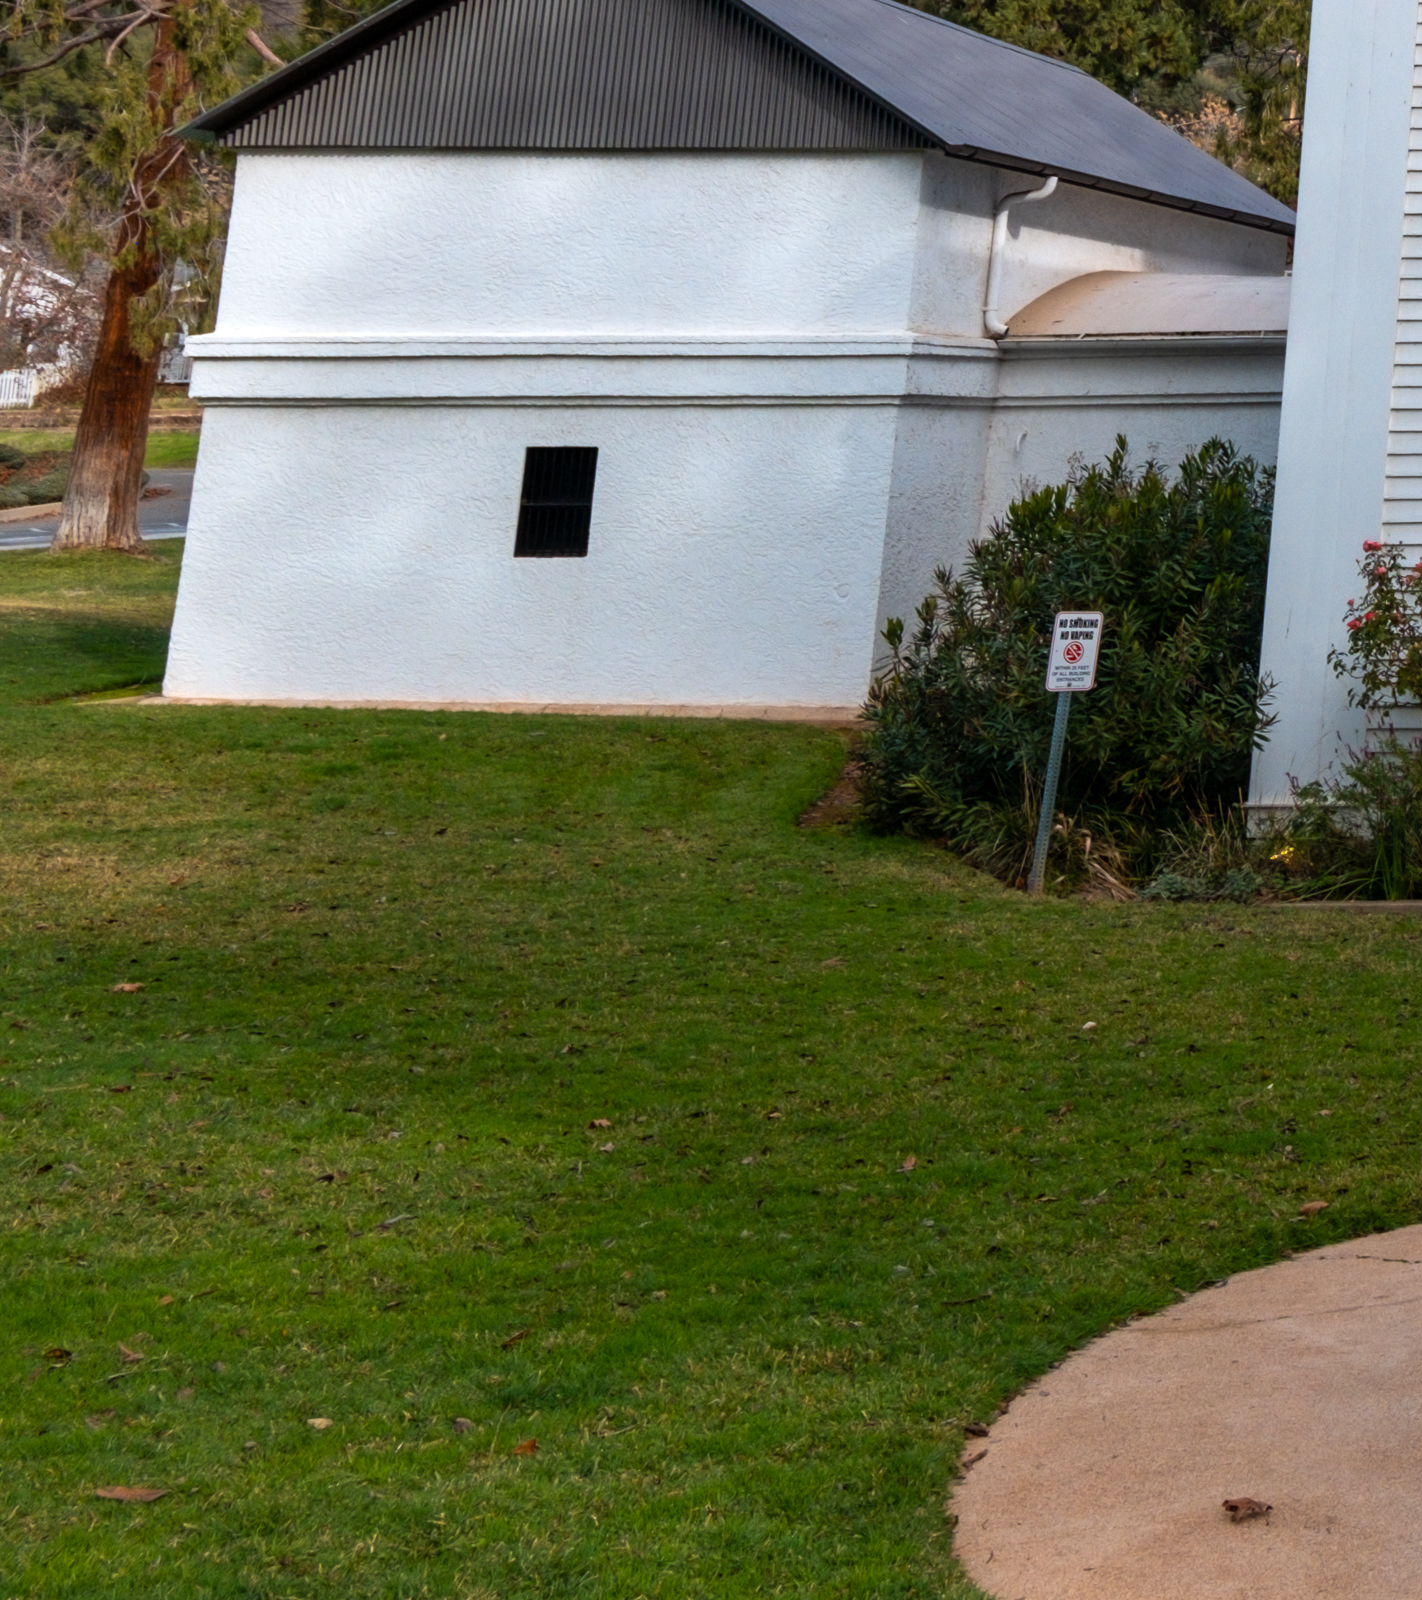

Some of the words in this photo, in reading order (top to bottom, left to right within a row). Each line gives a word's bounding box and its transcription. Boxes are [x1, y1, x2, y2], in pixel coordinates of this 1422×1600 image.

[1059, 619, 1068, 628] NO
[1069, 619, 1099, 628] SMOKING
[1061, 631, 1069, 640] NO
[1071, 631, 1094, 640] VAPING
